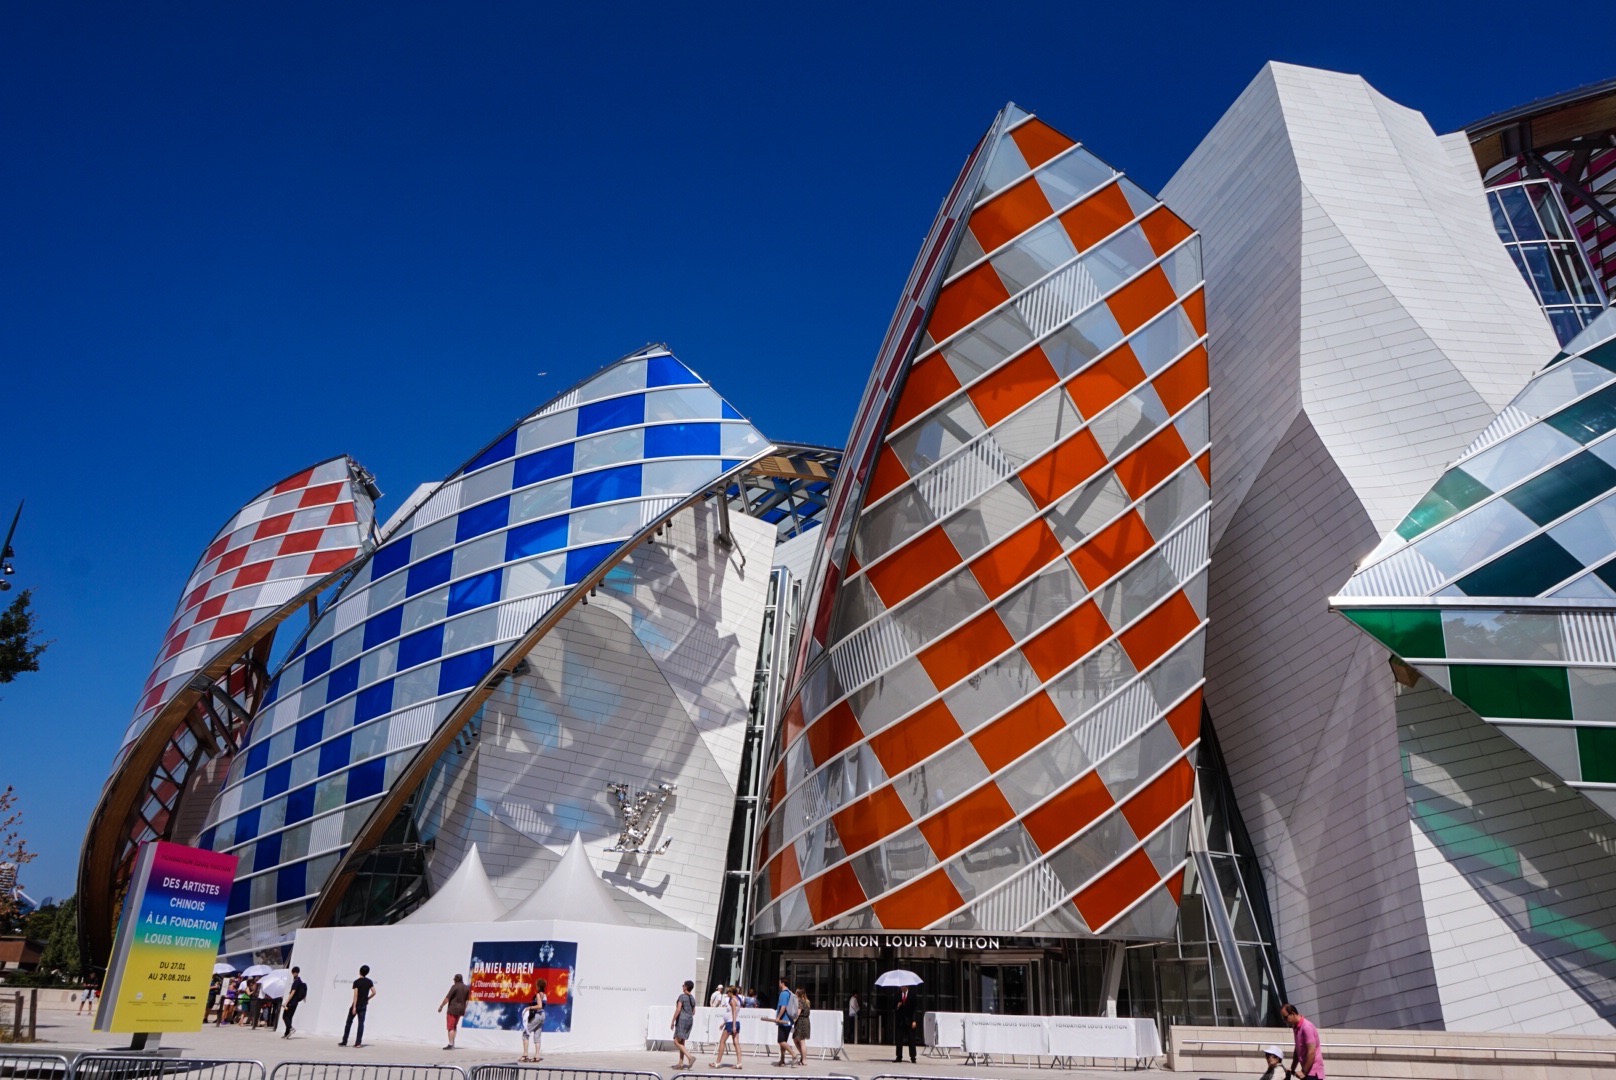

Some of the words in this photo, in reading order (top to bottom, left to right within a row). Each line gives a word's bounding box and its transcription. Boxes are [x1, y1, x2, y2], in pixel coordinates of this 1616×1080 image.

[163, 877, 180, 889] DES
[182, 880, 220, 895] ARTISTES
[170, 897, 206, 911] CHINOIS
[146, 911, 153, 924] À
[155, 914, 167, 925] LA
[170, 916, 218, 931] FONDATION
[144, 932, 172, 945] LOUIS
[175, 936, 211, 948] VUITTON
[816, 935, 878, 947] FONDATION
[885, 935, 927, 948] LOUIS
[934, 936, 1000, 949] VUITTON
[159, 961, 169, 969] DU
[170, 962, 186, 970] 27.01
[473, 962, 503, 974] DANIEL
[505, 962, 534, 974] BUREN
[159, 973, 191, 982] 29.08.2016
